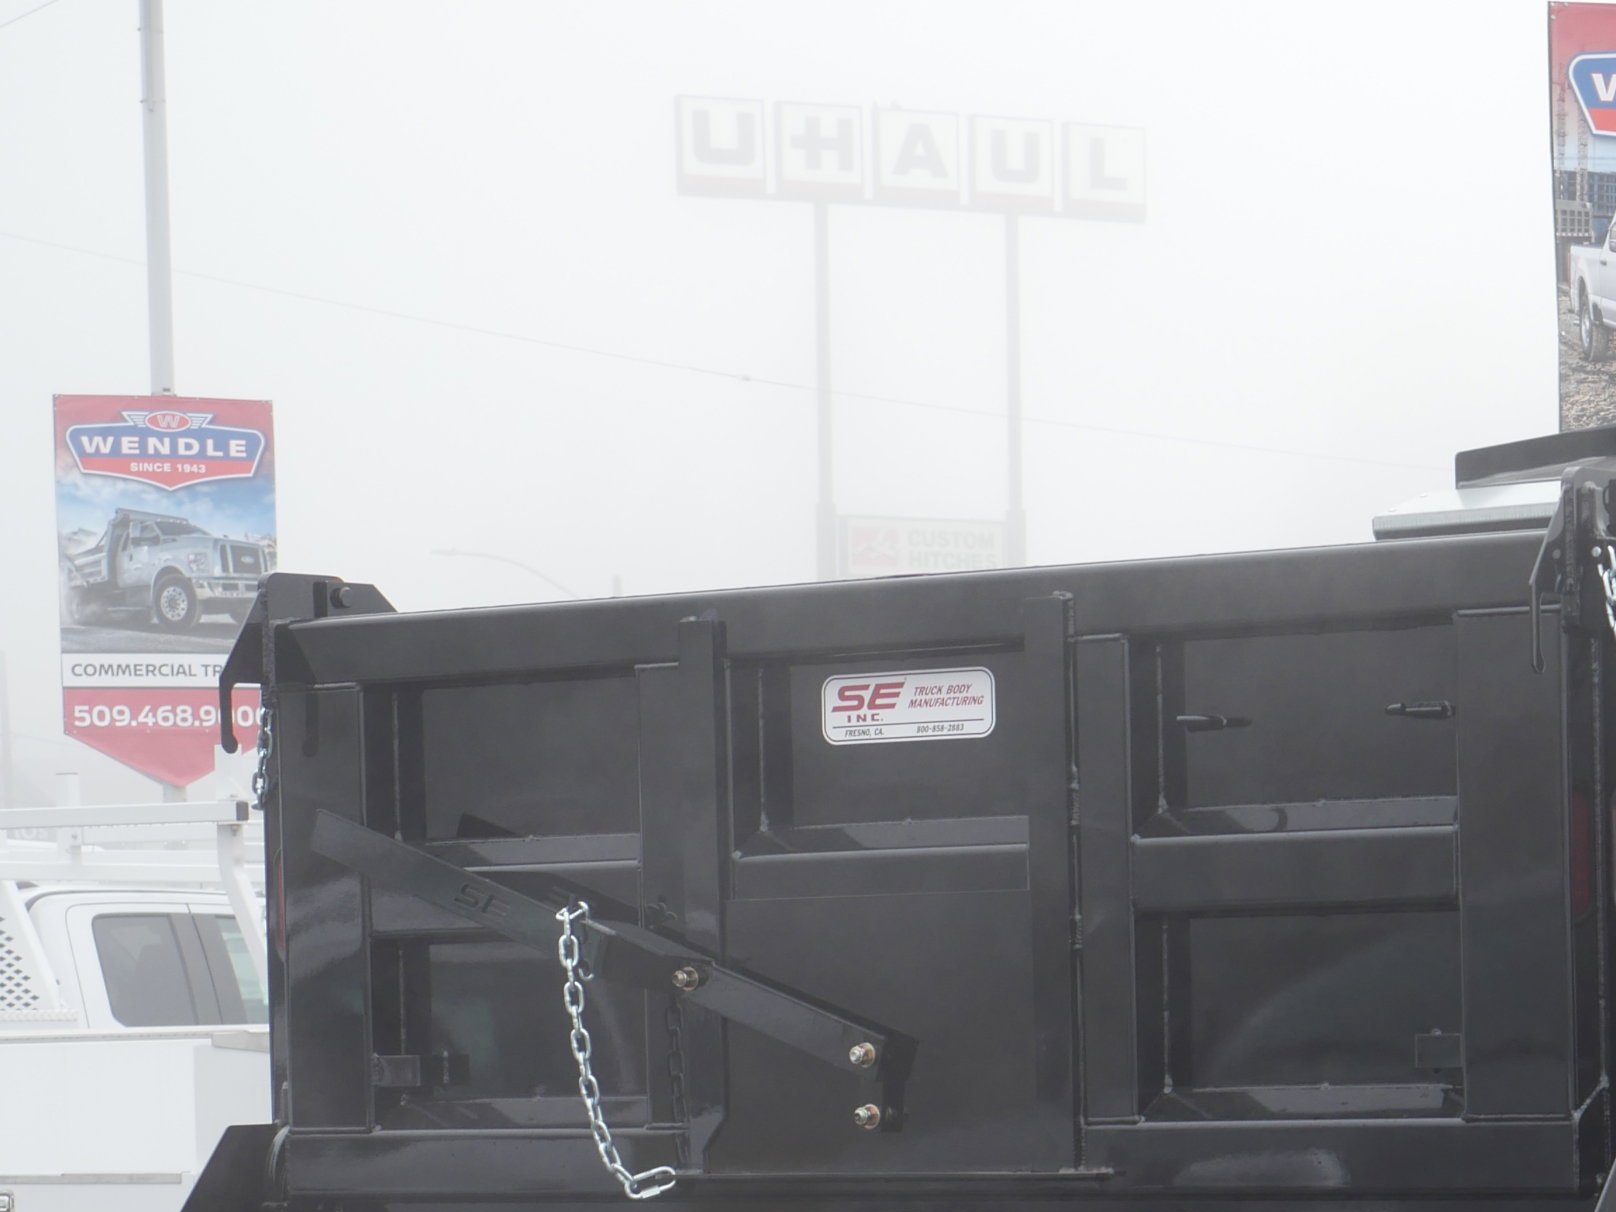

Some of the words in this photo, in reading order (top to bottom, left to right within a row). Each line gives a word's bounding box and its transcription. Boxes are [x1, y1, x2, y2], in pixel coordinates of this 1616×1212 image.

[80, 434, 248, 459] WENDLE
[129, 461, 172, 473] SINCE
[176, 463, 207, 474] 1943
[907, 528, 995, 549] CUSTOM
[908, 550, 998, 570] HITCHES
[71, 663, 197, 678] COMMERCIAL
[831, 681, 905, 713] SE
[914, 685, 943, 697] TRUCK
[946, 683, 973, 694] BODY
[907, 695, 985, 709] MANUFACTURING
[847, 713, 884, 723] INC.
[844, 729, 872, 738] FRESNO,
